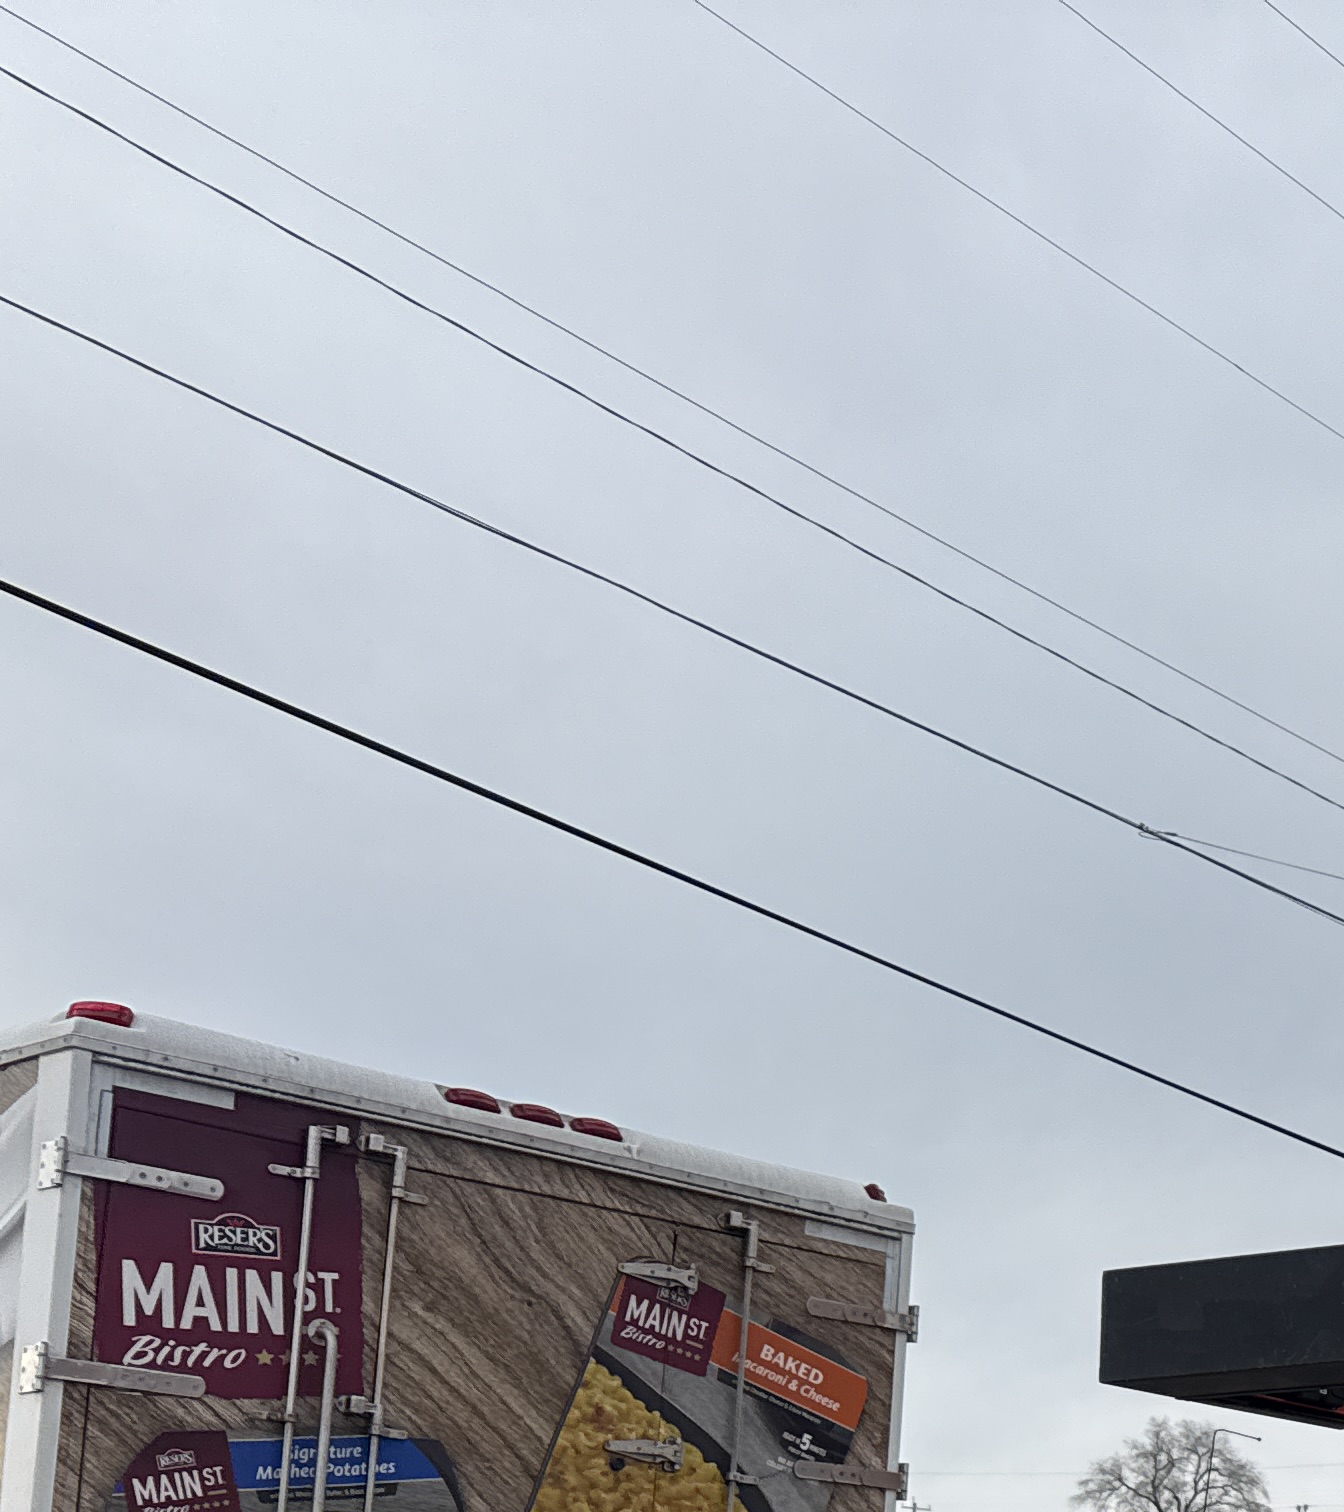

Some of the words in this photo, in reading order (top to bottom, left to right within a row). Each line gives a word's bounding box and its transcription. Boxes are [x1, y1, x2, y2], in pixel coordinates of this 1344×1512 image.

[121, 1259, 285, 1335] MAIN
[620, 1325, 665, 1349] Bistro
[625, 1294, 687, 1341] MAIN
[122, 1335, 246, 1369] Bistro
[760, 1344, 824, 1385] BAKED
[731, 1352, 789, 1387] acaroni
[788, 1379, 799, 1392] &
[800, 1384, 841, 1412] Cheese
[800, 1432, 813, 1451] 5
[131, 1469, 204, 1506] MAIN
